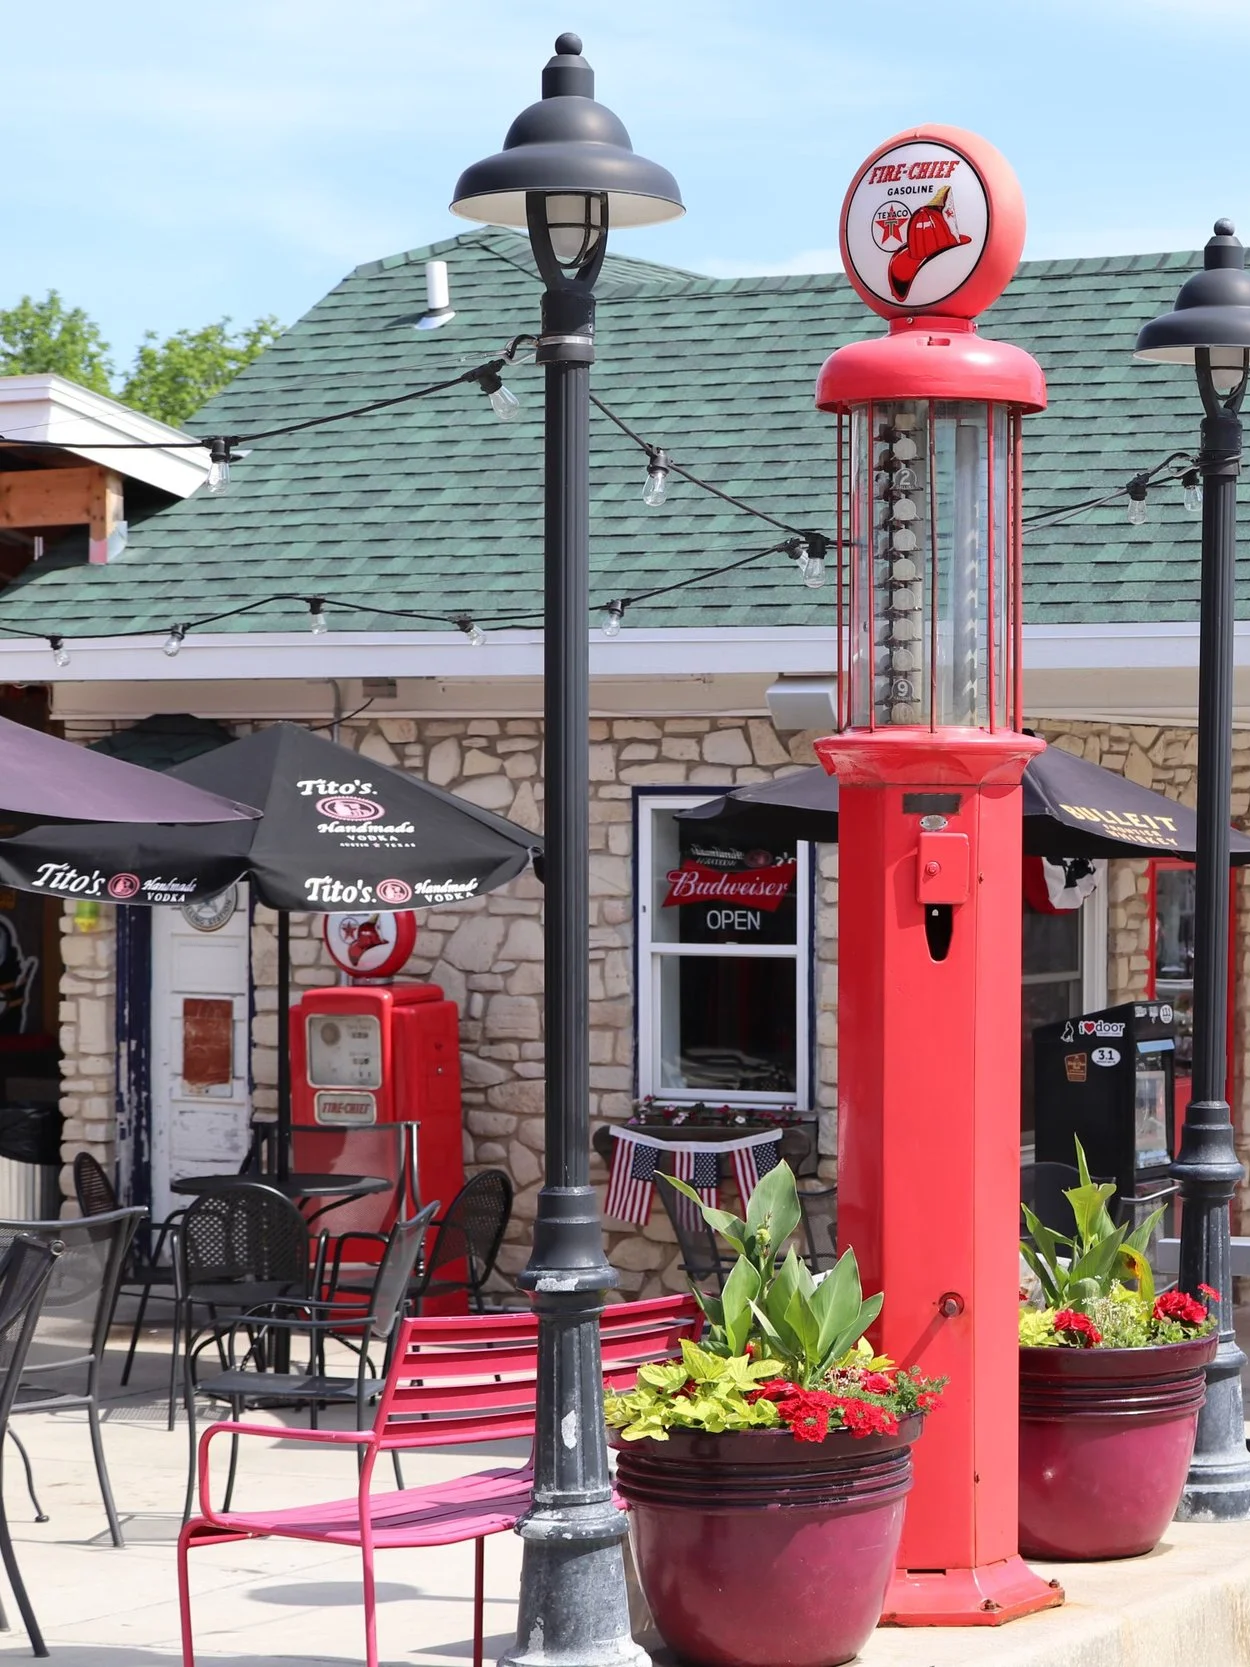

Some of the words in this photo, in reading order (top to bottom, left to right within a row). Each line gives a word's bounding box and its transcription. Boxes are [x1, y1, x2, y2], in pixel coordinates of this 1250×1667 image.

[868, 160, 960, 185] FIRE-CHIEF
[887, 185, 934, 197] GASOLINE
[878, 210, 908, 219] TEXACO
[900, 470, 910, 485] 2
[898, 681, 908, 697] 9
[1059, 803, 1178, 831] BULLEIT
[317, 821, 415, 833] Handmade
[141, 876, 197, 892] Handmade
[414, 878, 479, 895] Handmade
[667, 870, 788, 896] Budweiser
[147, 893, 186, 902] VODKA
[424, 891, 475, 903] VODKA
[707, 910, 761, 931] OPEN
[1095, 1021, 1125, 1032] door
[1098, 1050, 1114, 1060] 3.1
